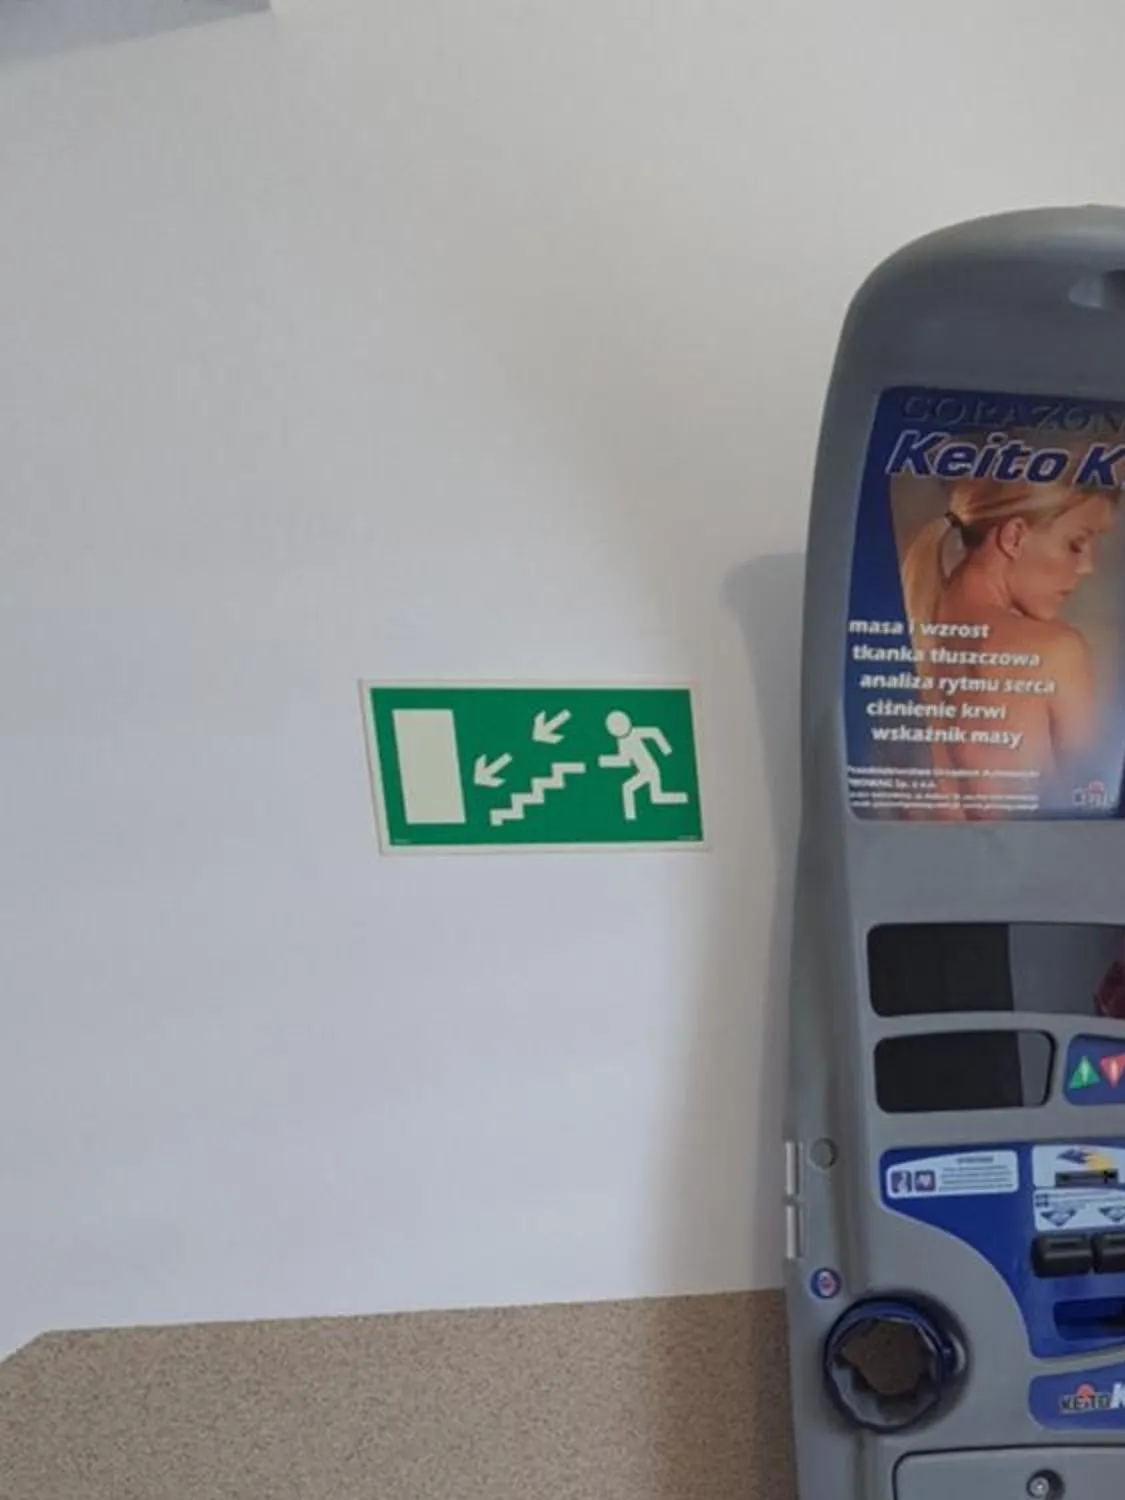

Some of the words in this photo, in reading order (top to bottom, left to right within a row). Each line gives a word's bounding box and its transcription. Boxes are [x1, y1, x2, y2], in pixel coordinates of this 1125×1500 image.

[885, 429, 1070, 485] Keito
[848, 618, 903, 635] masa
[920, 622, 990, 639] wzrost
[852, 645, 924, 662] tkanka
[929, 648, 1041, 667] tłuszczowa
[860, 672, 934, 690] analiza
[938, 675, 999, 696] rytmu
[1003, 678, 1056, 694] serca
[866, 700, 957, 719] ciśnienie
[961, 703, 1007, 720] krwi
[970, 729, 1024, 751] masy
